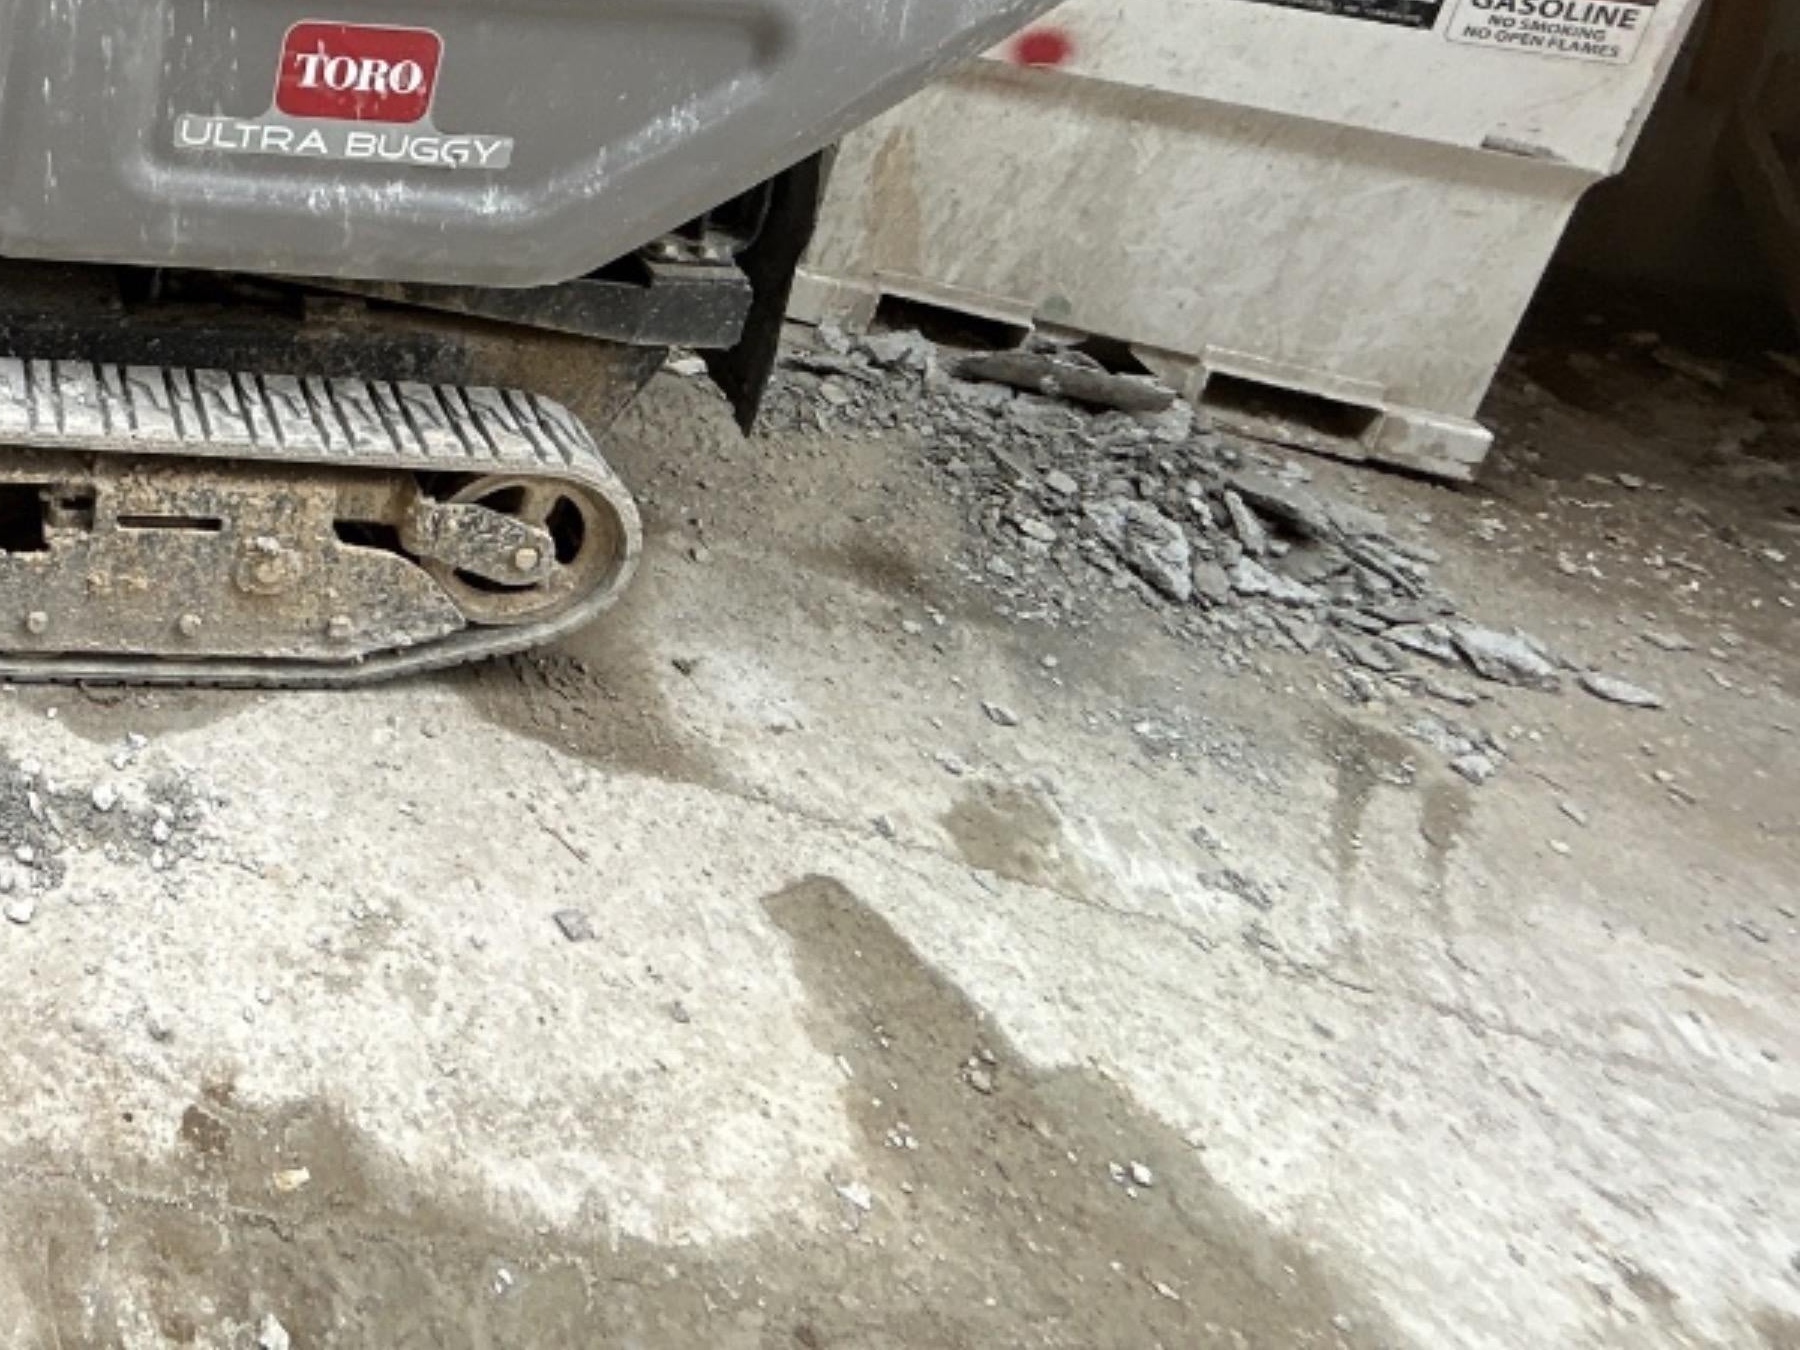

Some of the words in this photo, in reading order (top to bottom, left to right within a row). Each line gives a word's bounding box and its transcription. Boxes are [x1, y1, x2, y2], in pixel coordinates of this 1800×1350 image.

[1463, 24, 1492, 40] NO
[1493, 28, 1544, 47] OPEN
[1547, 36, 1621, 58] FLAMES
[1487, 13, 1516, 28] NO
[1520, 16, 1606, 42] SMOKING
[293, 52, 424, 96] TORO
[180, 119, 328, 155] ULTRA
[344, 130, 503, 167] BUGGY
